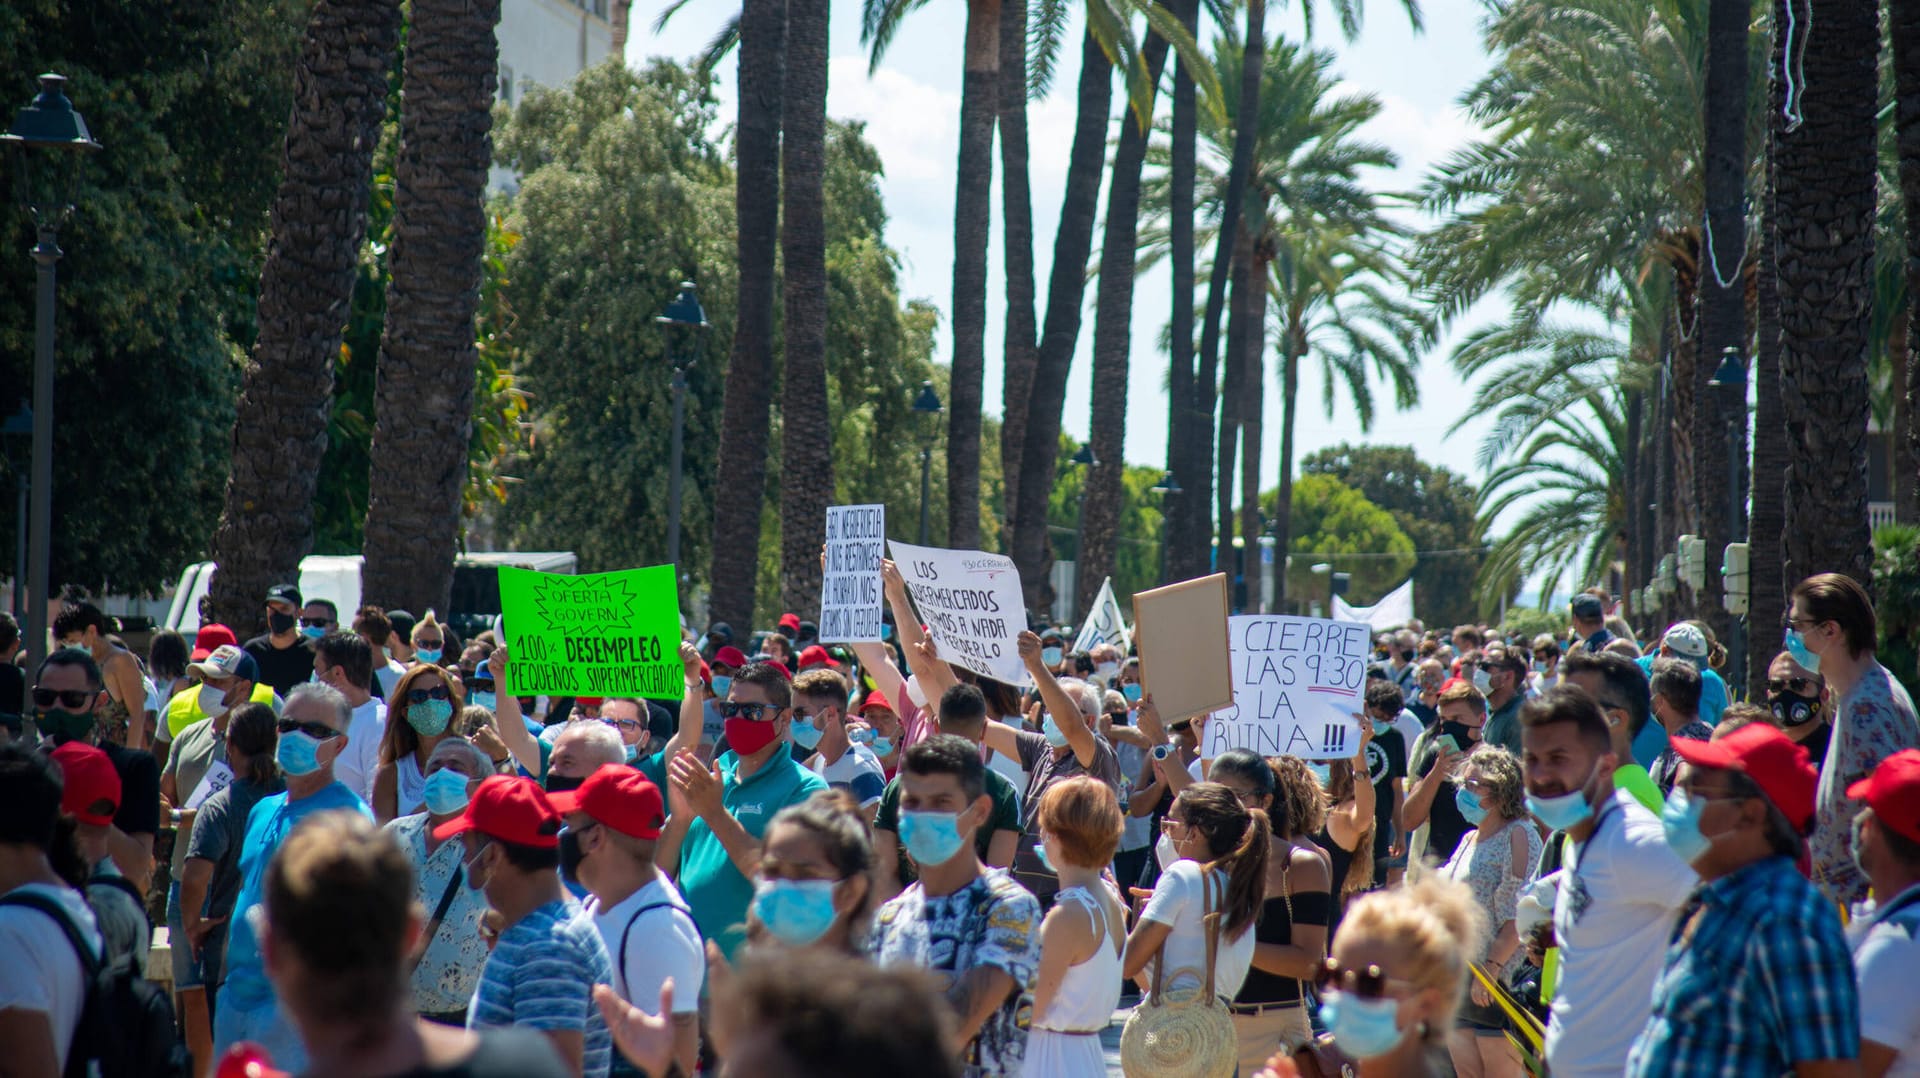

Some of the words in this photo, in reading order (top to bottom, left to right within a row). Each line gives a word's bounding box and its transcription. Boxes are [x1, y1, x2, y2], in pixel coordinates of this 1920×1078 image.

[913, 560, 938, 580] LOS
[552, 589, 612, 604] OFERTA
[860, 575, 877, 605] NOS
[554, 606, 618, 622] GOVERN
[959, 616, 968, 636] A
[971, 617, 1007, 639] NADA
[565, 634, 661, 664] DESEMPLEO
[943, 631, 1001, 659] PERDERLO
[1245, 621, 1363, 658] CIERRE
[511, 661, 579, 692] PEQUEÑOS
[587, 664, 682, 697] SUPERMERCADOS
[960, 655, 992, 676] TODO
[1245, 655, 1297, 686] LAS
[1258, 690, 1296, 720] LA
[1212, 722, 1314, 755] RUINA
